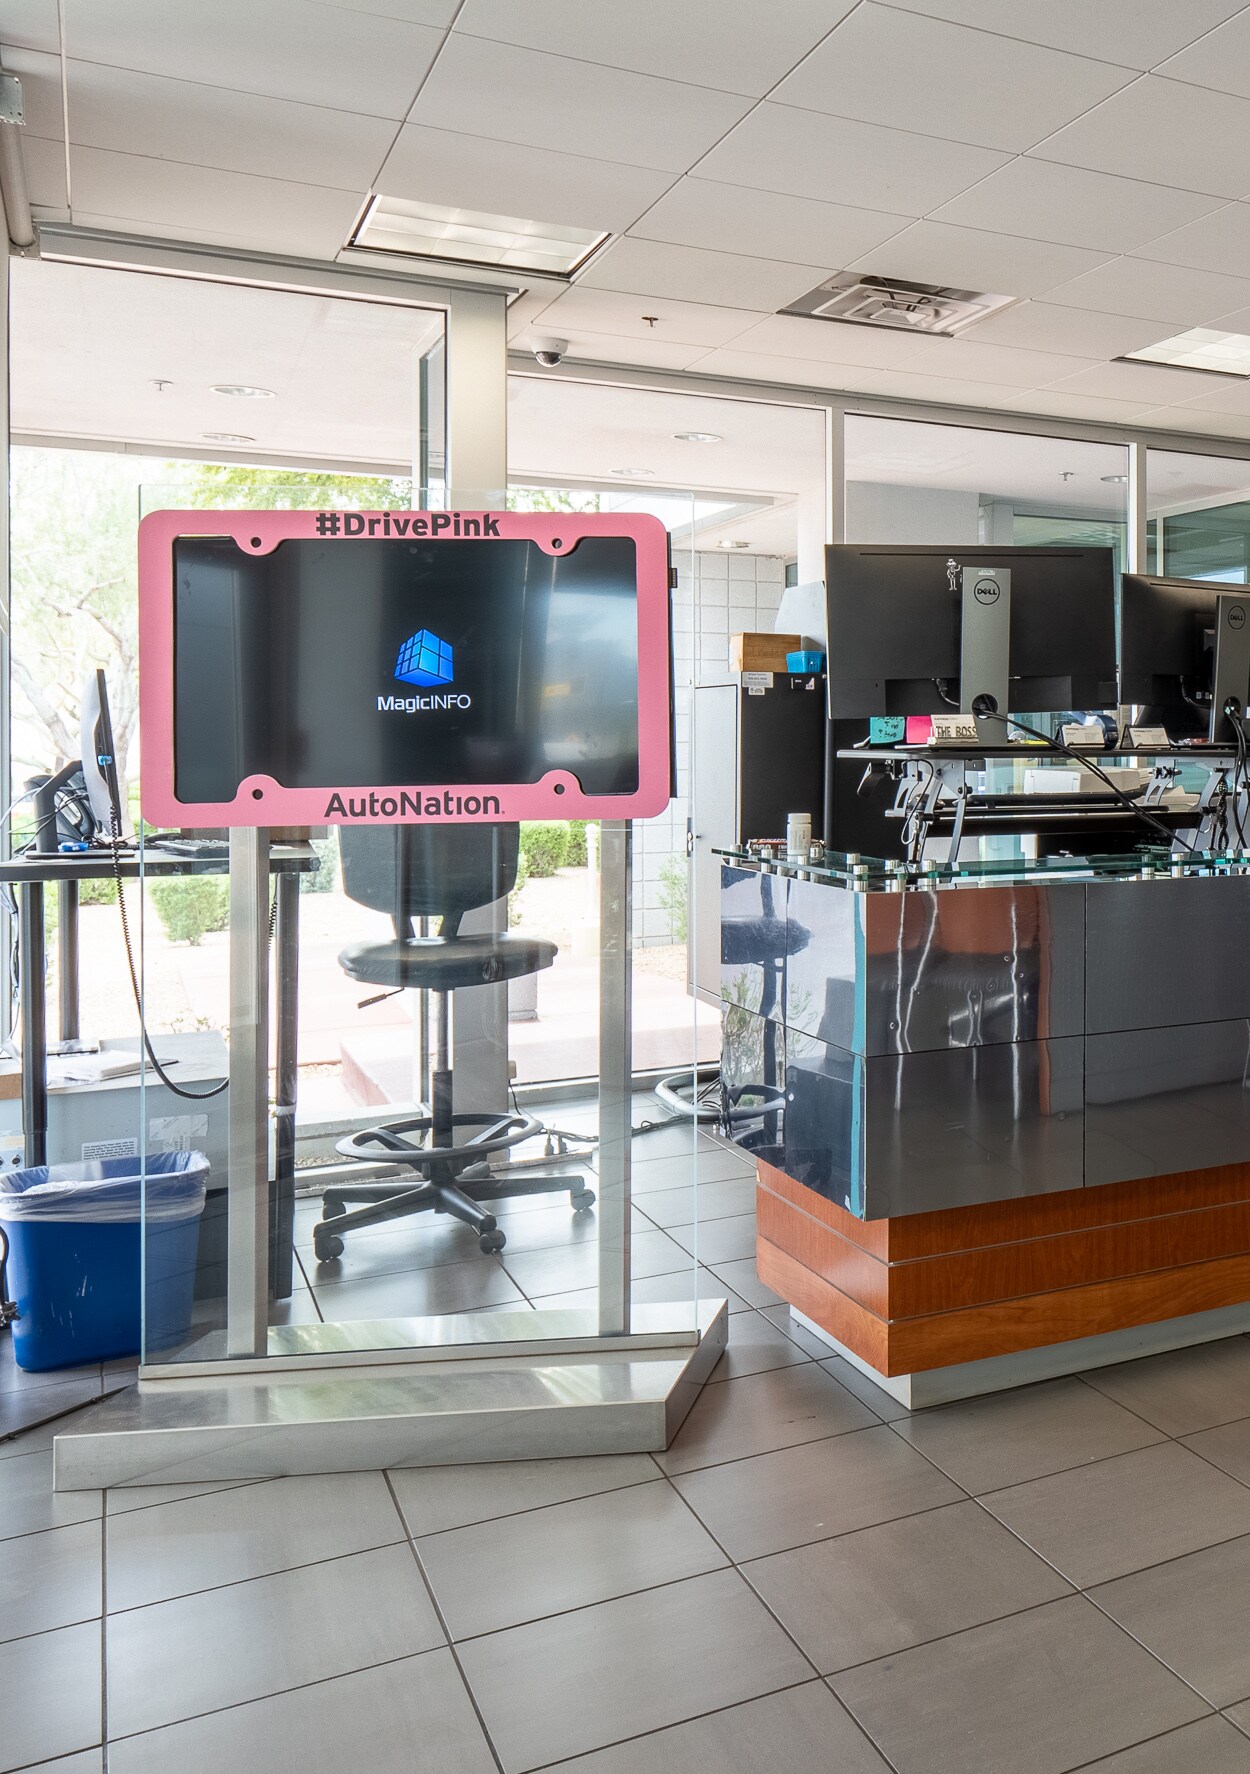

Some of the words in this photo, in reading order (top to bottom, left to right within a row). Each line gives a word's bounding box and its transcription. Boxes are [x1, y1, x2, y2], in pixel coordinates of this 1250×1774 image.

[315, 511, 501, 537] #DrivePink
[977, 588, 998, 596] DELL
[377, 694, 472, 714] MagicINFO
[935, 725, 951, 738] THE
[323, 790, 500, 818] AutoNation
